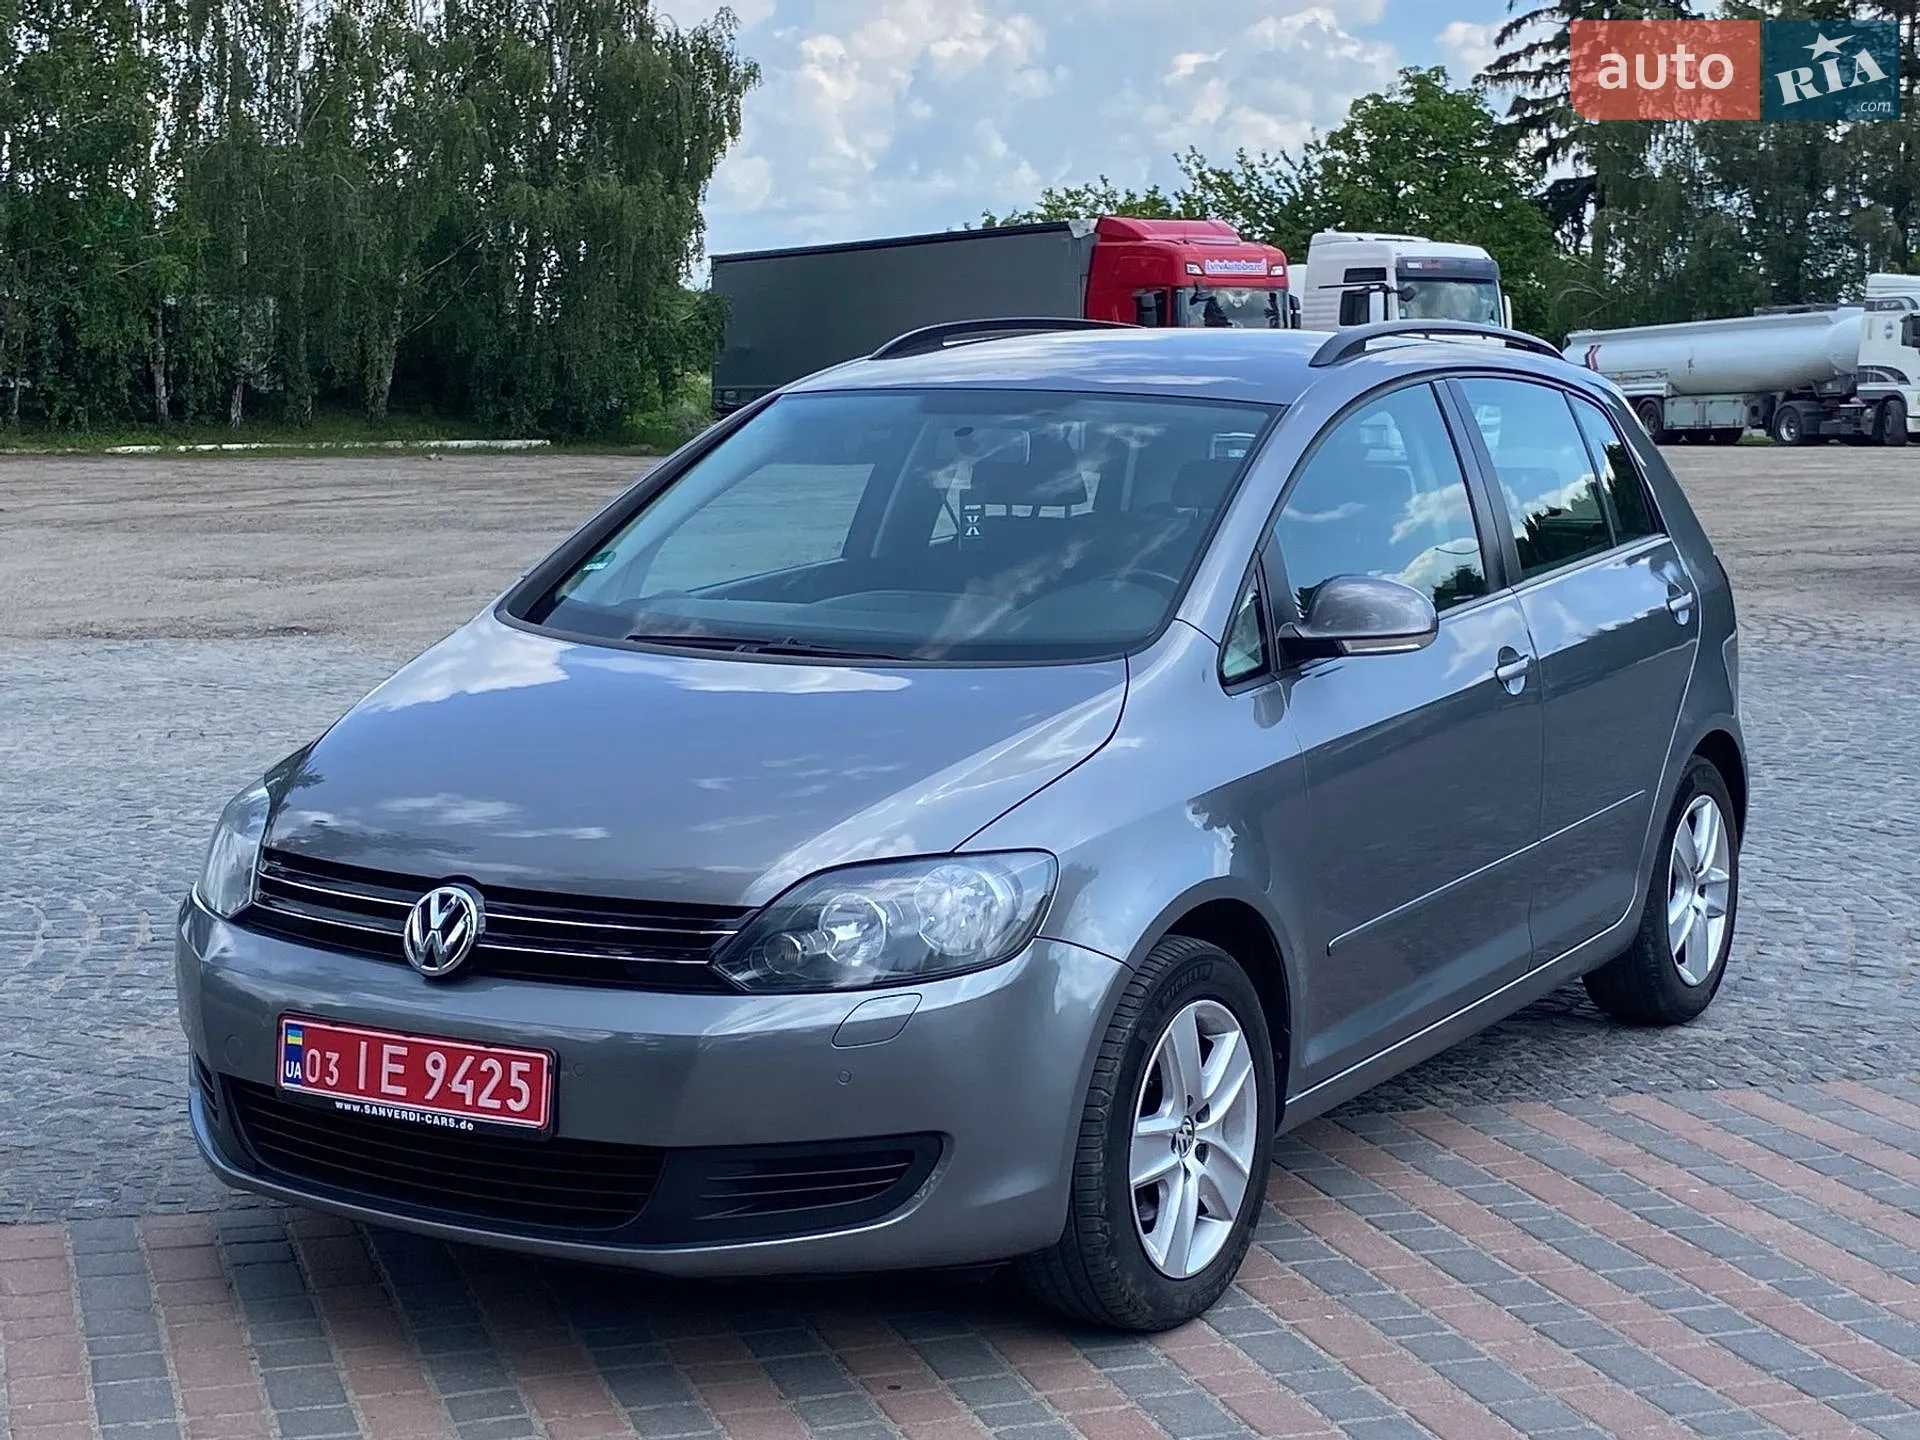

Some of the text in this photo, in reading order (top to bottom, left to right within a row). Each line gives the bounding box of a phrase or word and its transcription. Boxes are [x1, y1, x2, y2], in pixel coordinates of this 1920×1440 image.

[285, 1060, 302, 1079] UA
[306, 1041, 531, 1112] 03 IE 9425
